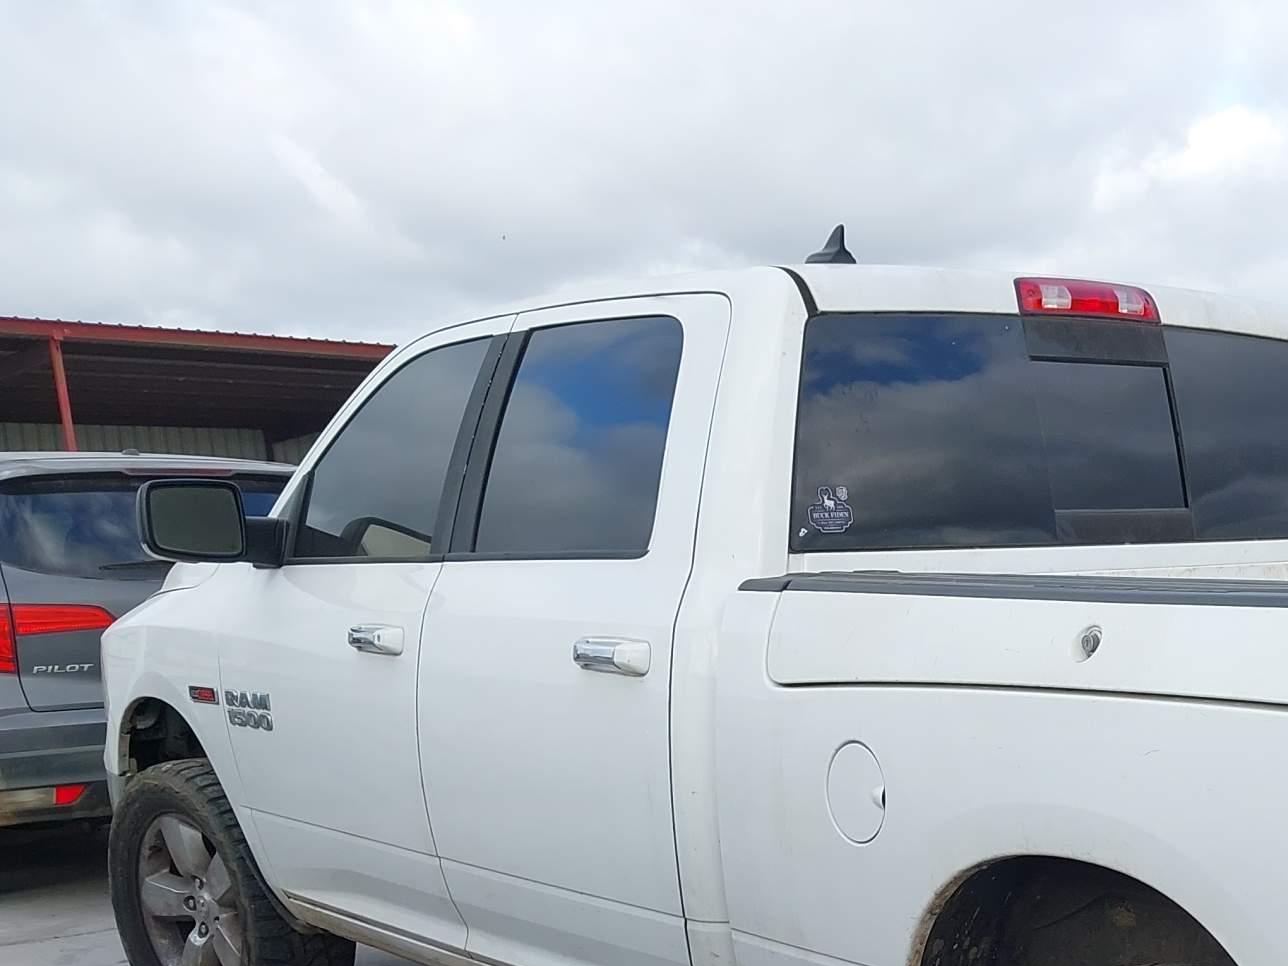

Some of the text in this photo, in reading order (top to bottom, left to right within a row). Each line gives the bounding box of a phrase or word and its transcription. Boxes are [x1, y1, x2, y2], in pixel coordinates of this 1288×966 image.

[32, 663, 95, 675] PILOT
[224, 690, 271, 711] RAM
[227, 709, 274, 731] 1500
